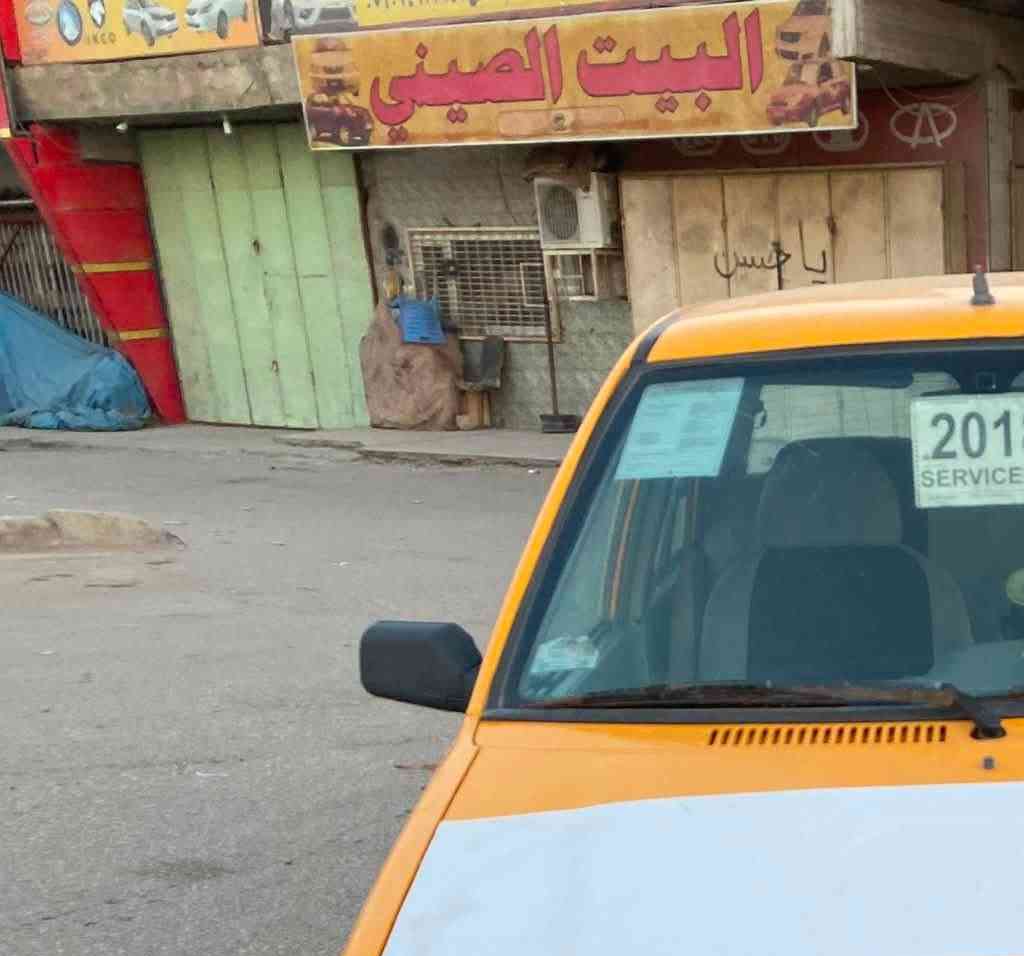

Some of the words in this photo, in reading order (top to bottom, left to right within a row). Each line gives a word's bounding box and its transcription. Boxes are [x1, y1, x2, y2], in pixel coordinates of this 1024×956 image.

[370, 23, 563, 143] الصيني
[577, 8, 763, 112] البيت
[921, 466, 1024, 488] SERVICE
